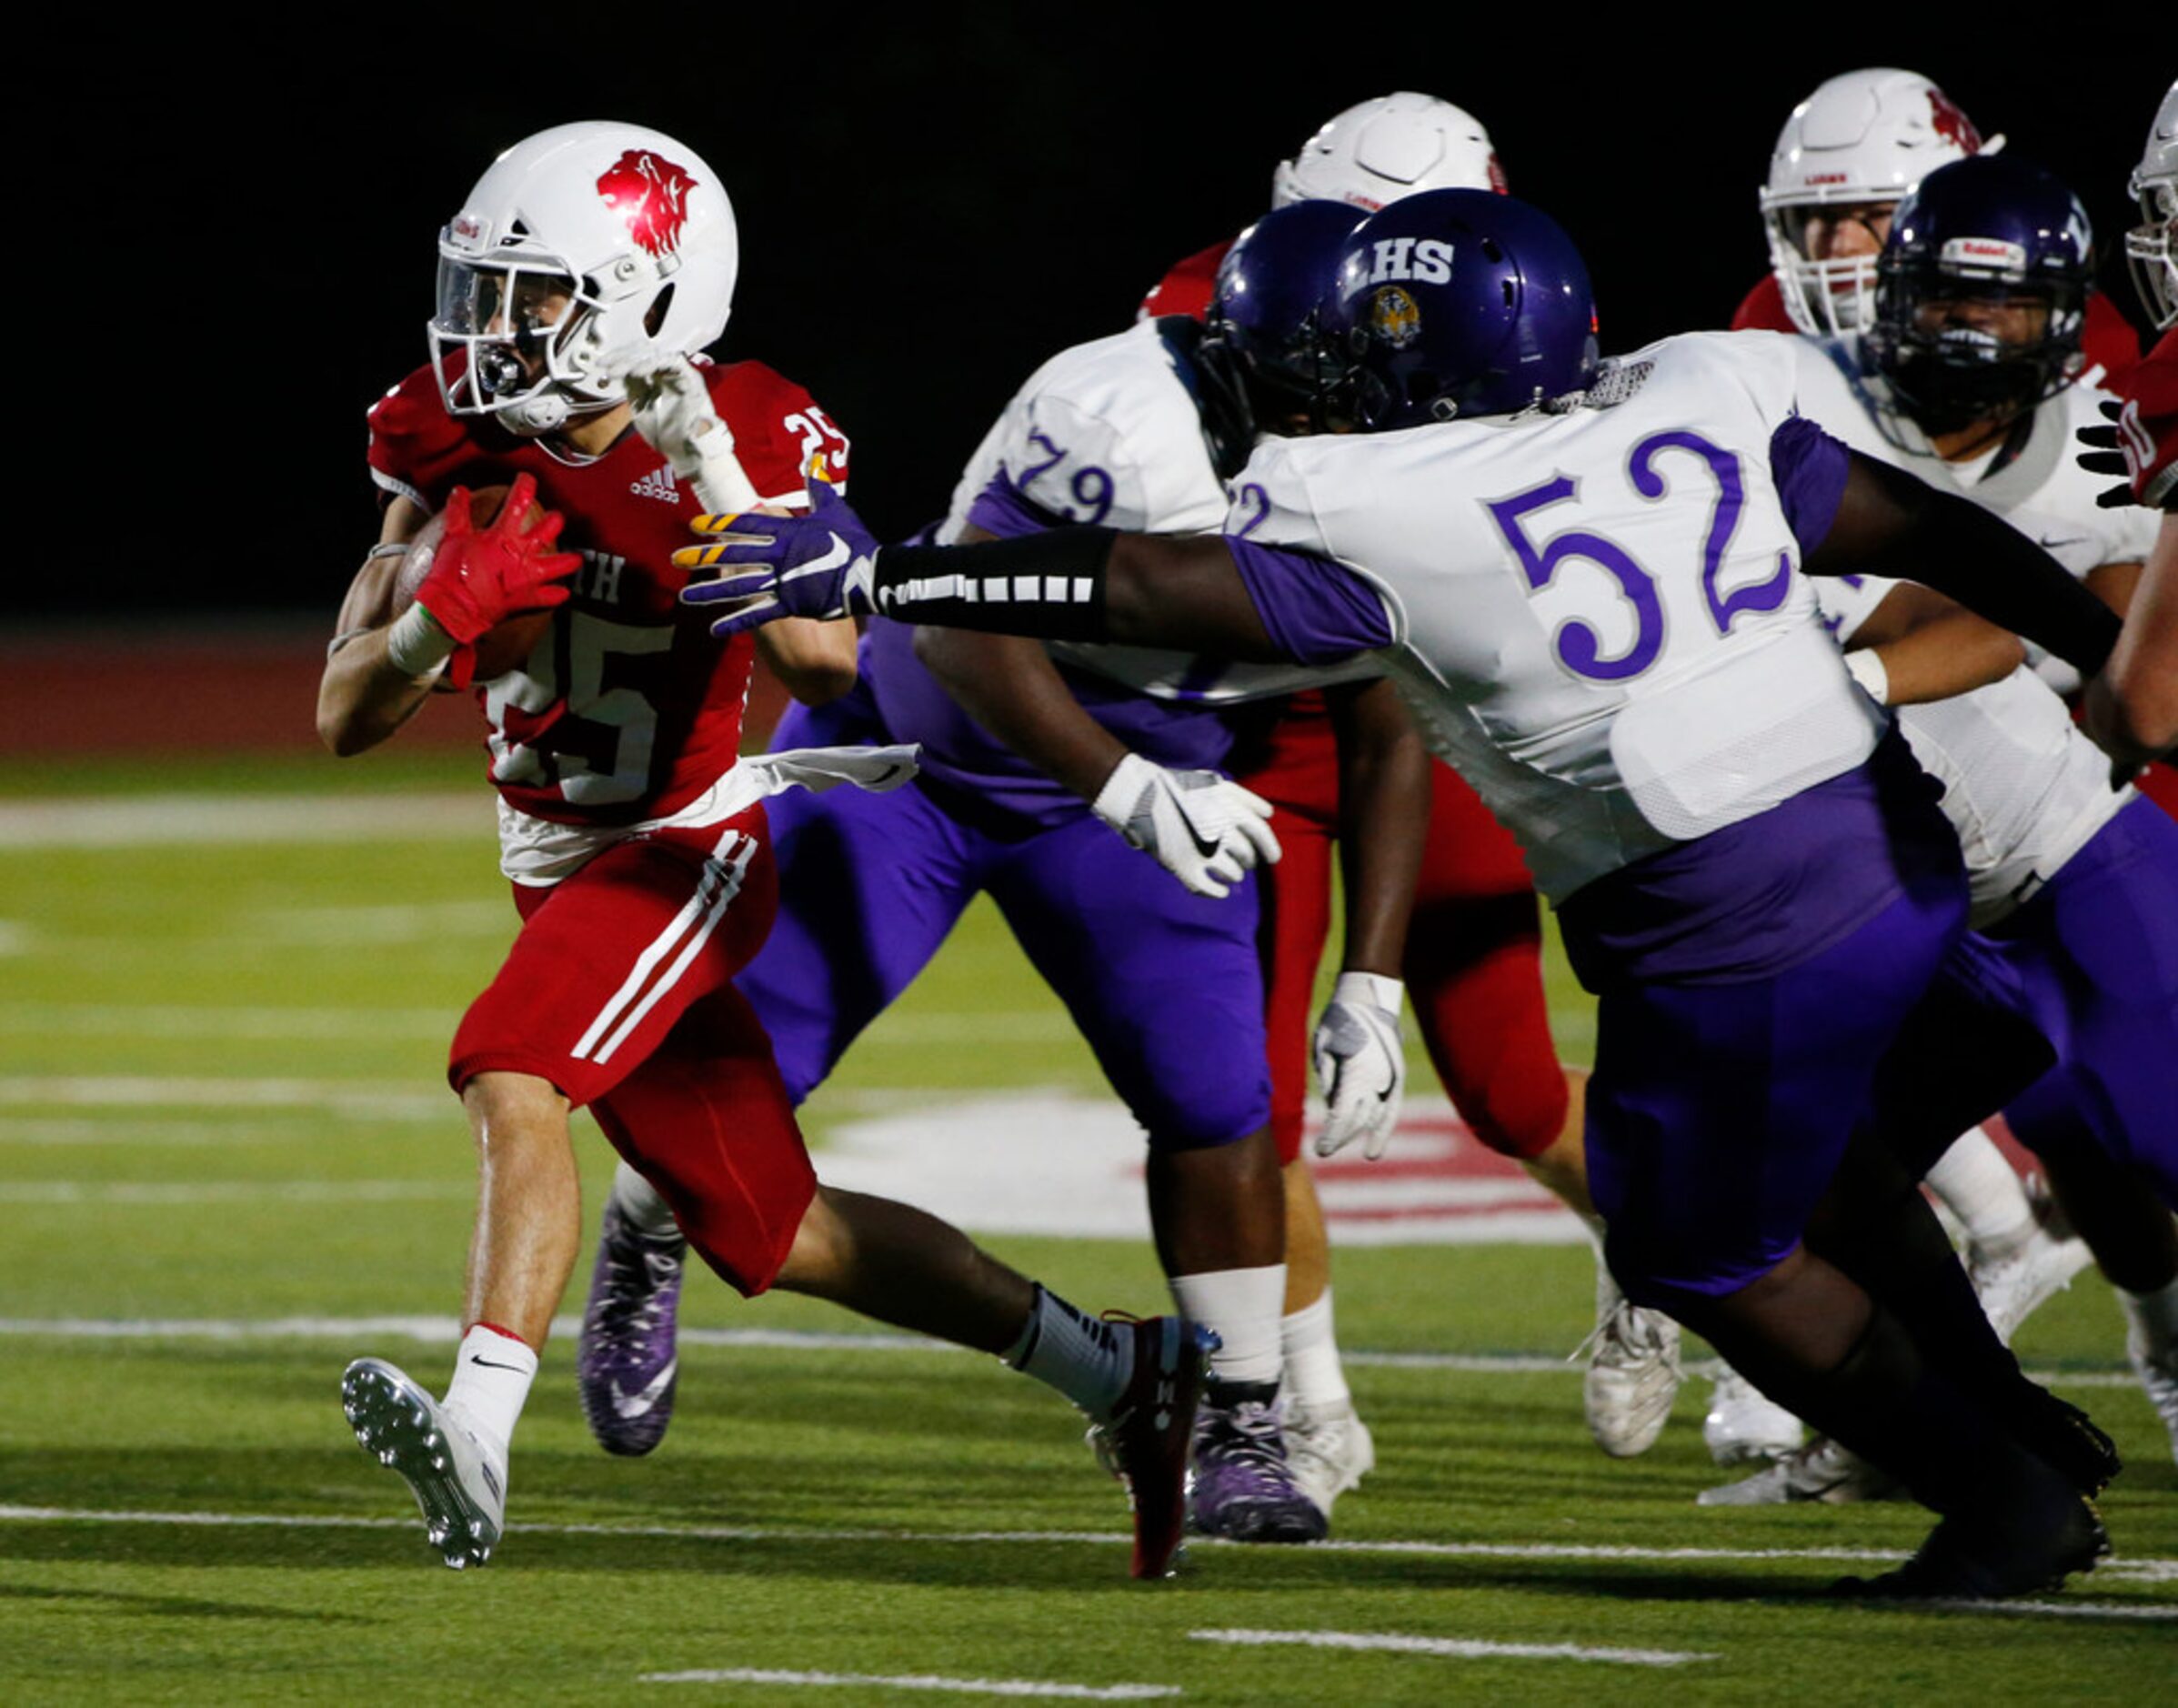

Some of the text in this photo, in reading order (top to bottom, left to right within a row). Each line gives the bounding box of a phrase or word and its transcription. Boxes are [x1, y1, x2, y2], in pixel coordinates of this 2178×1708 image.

[1343, 237, 1455, 302] LHS
[783, 406, 850, 477] 25
[1018, 426, 1114, 524] 79
[629, 482, 680, 505] adidas
[1475, 427, 1797, 686] 52
[485, 608, 677, 806] 25
